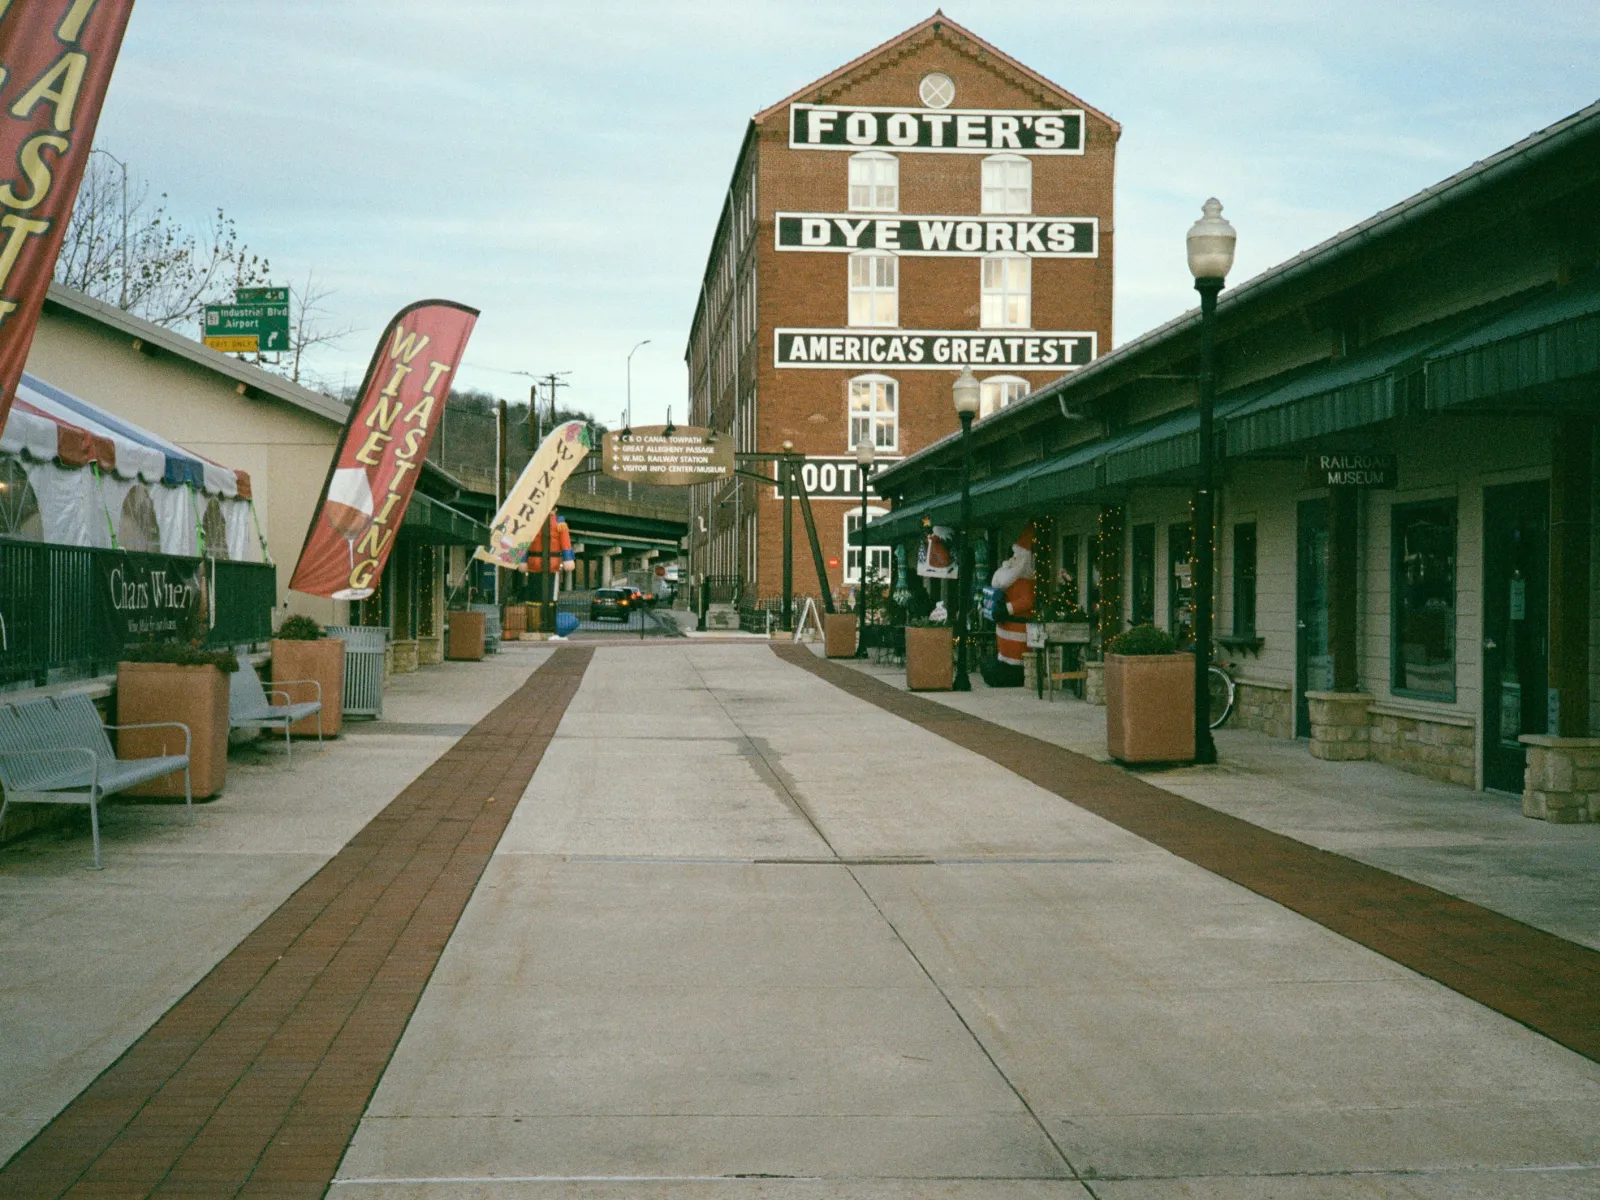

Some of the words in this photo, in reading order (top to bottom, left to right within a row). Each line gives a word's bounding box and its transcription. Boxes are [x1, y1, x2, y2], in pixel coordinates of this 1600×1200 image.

[808, 110, 1065, 149] FOOTER'S
[801, 218, 902, 250] DYE
[918, 221, 1076, 252] WORKS
[221, 308, 264, 317] Industrial
[267, 308, 287, 316] Blvd
[225, 319, 259, 329] Airport
[789, 335, 924, 363] AMERICA'S
[933, 337, 1078, 364] GREATEST
[355, 325, 429, 466] WINE
[669, 436, 702, 444] TOWPATH
[647, 445, 684, 453] ALLEGHENY
[686, 446, 715, 454] PASSAGE
[647, 455, 680, 463] RAILWAY
[1320, 456, 1390, 469] RAILROAD
[348, 361, 451, 590] TASTING
[1328, 471, 1384, 484] MUSEUM
[511, 438, 574, 536] WINERY
